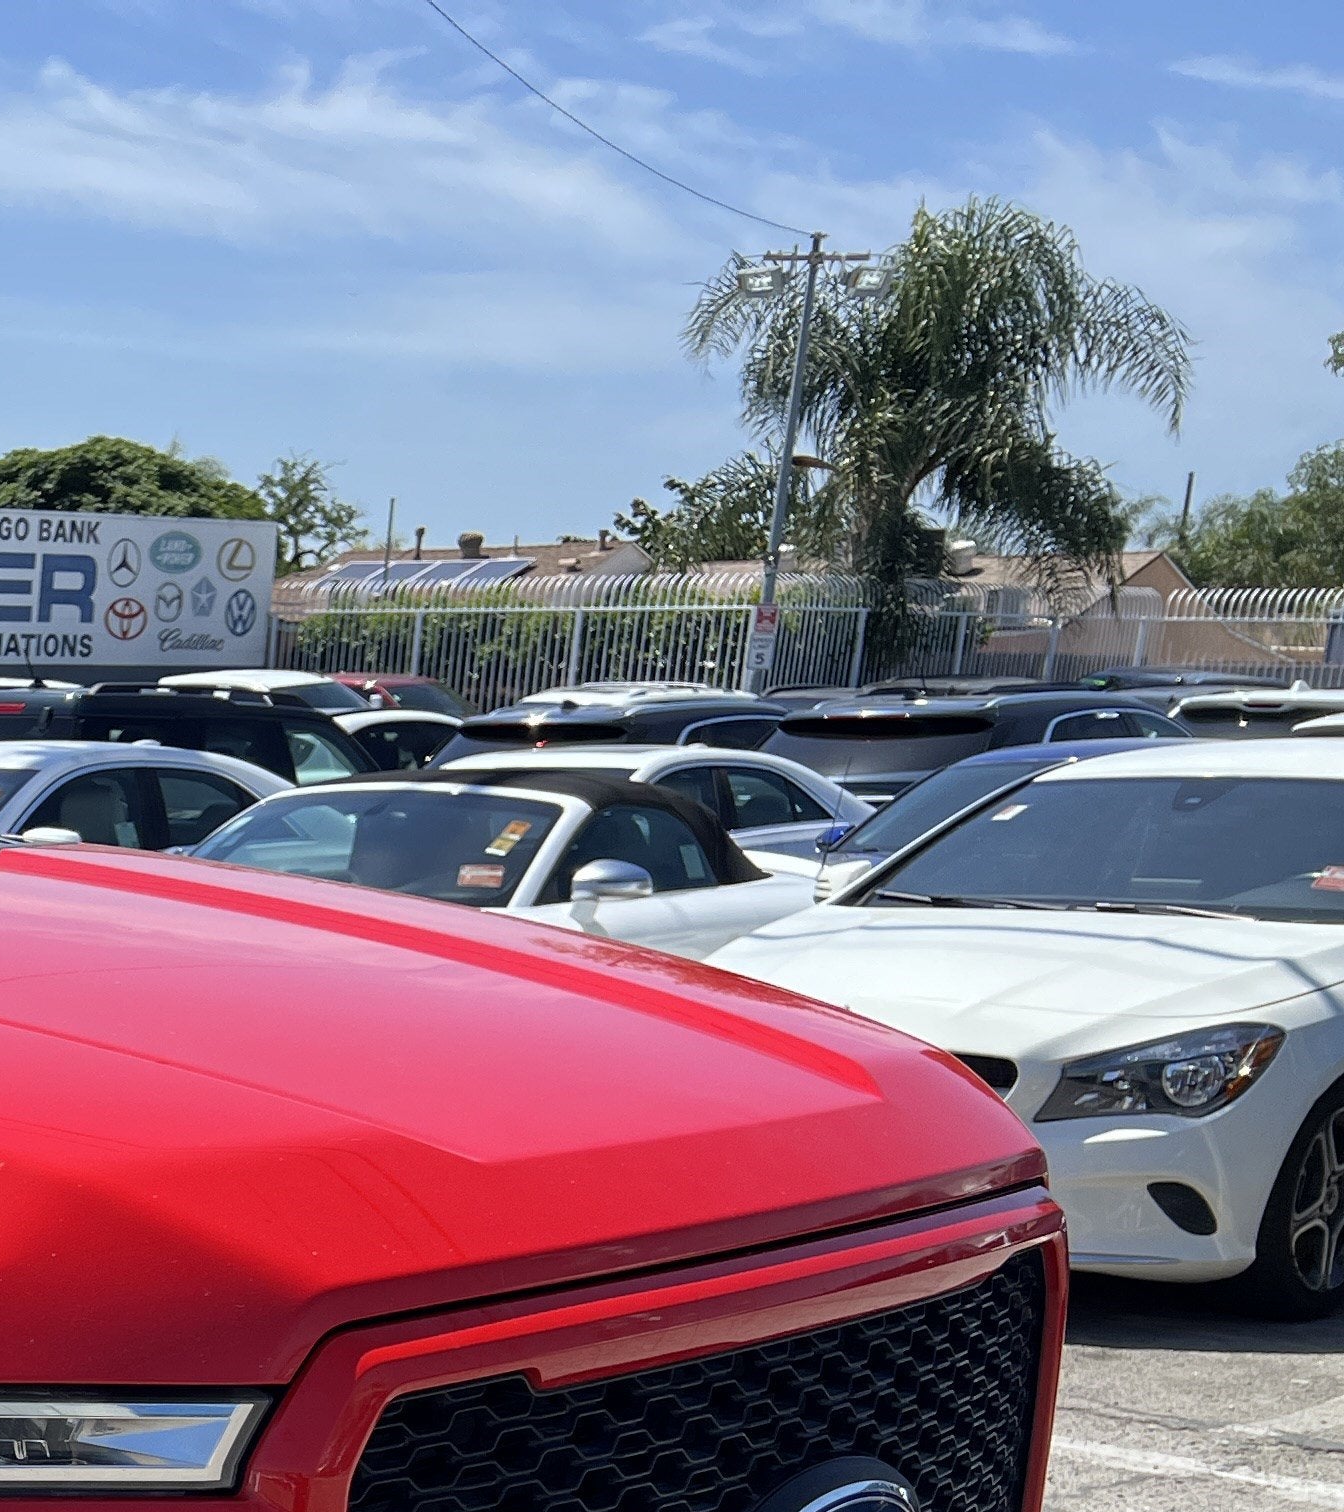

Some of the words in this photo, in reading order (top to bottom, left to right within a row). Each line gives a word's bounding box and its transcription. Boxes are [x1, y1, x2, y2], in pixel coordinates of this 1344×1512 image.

[38, 519, 101, 544] BANK
[157, 627, 225, 652] Cadillac
[754, 652, 765, 664] 5
